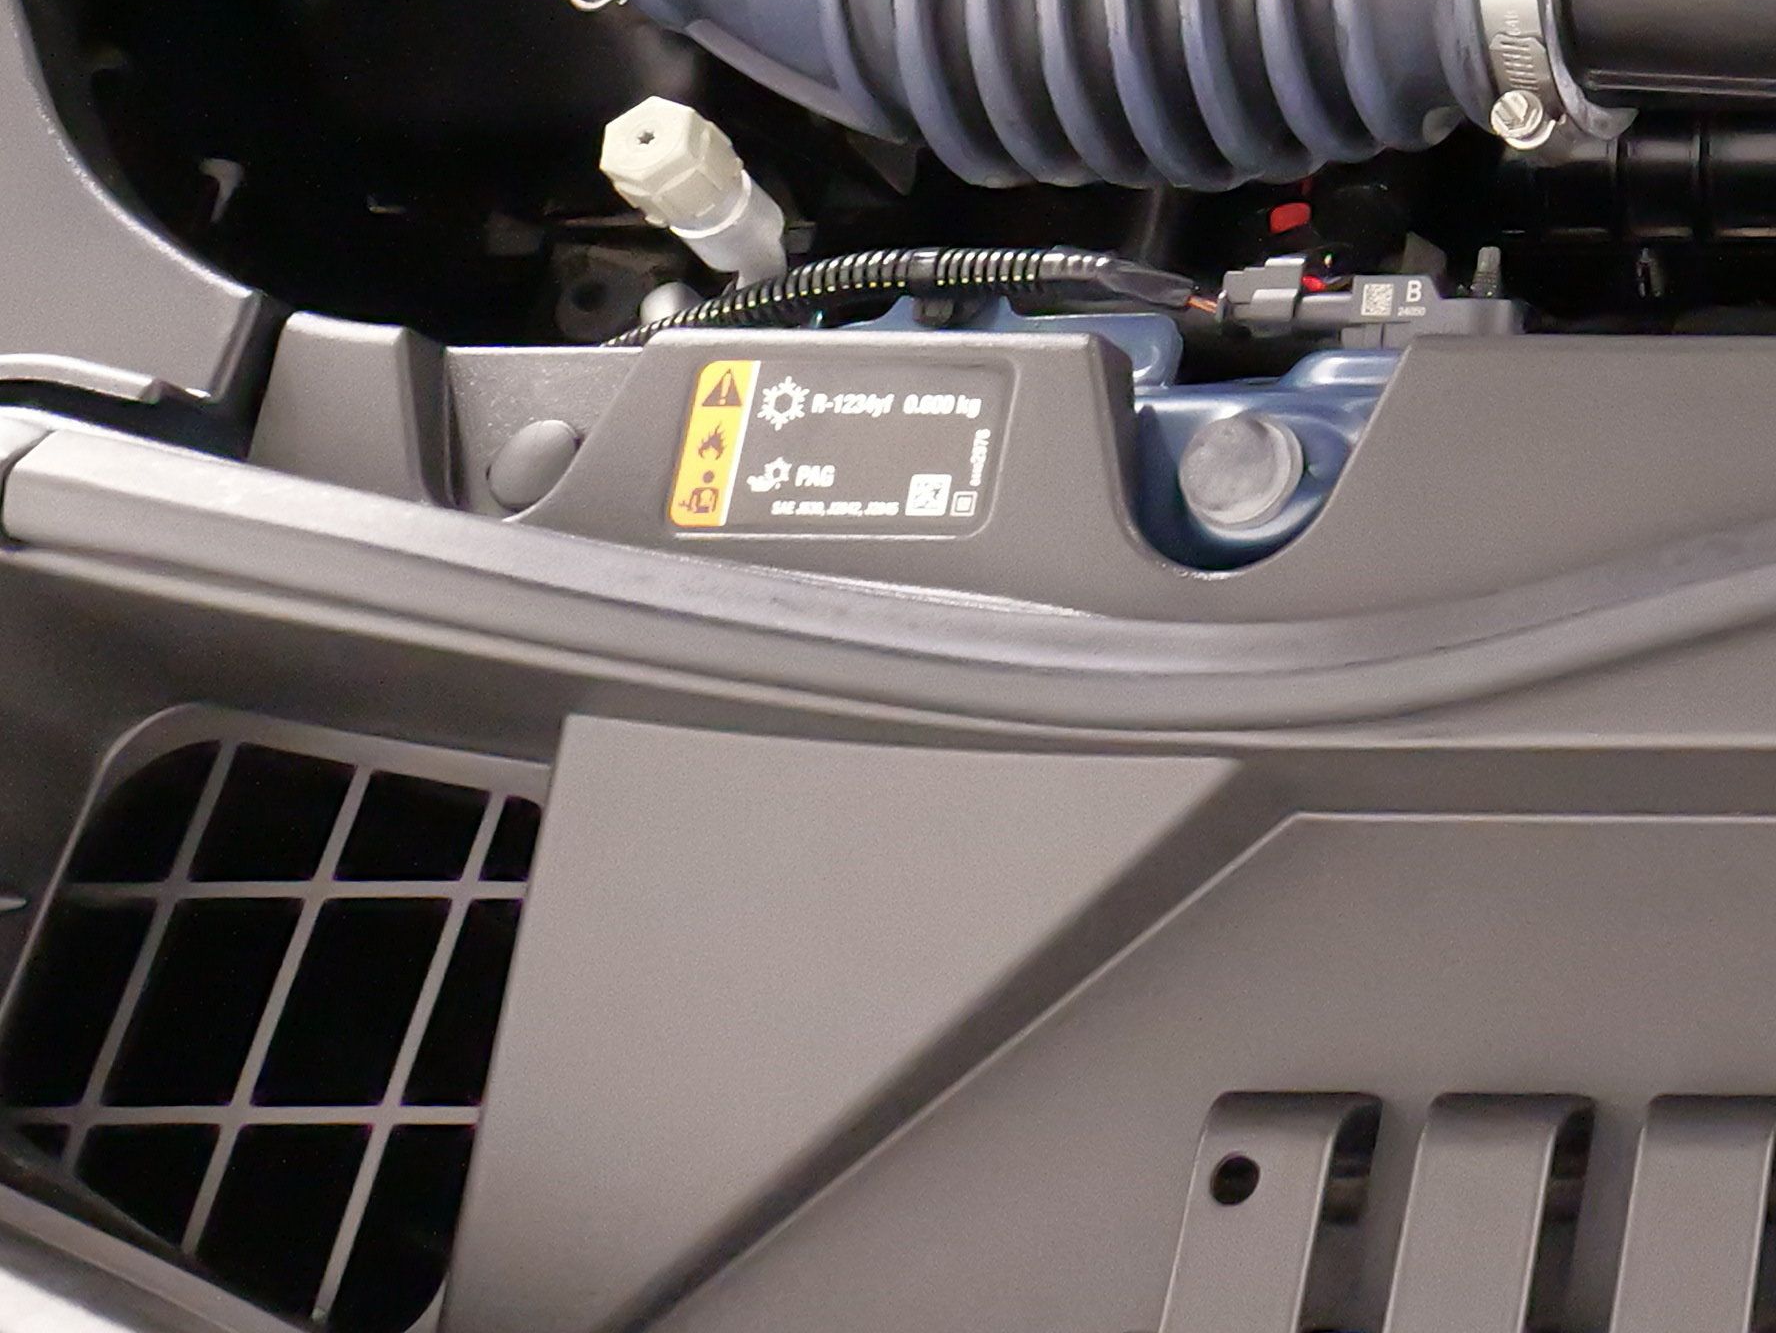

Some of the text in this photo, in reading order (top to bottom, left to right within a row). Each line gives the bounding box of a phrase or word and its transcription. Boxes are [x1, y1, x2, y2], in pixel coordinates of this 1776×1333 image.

[1406, 279, 1422, 302] B
[811, 393, 895, 418] R-1234yf
[955, 394, 982, 419] kg
[795, 464, 836, 487] PAG
